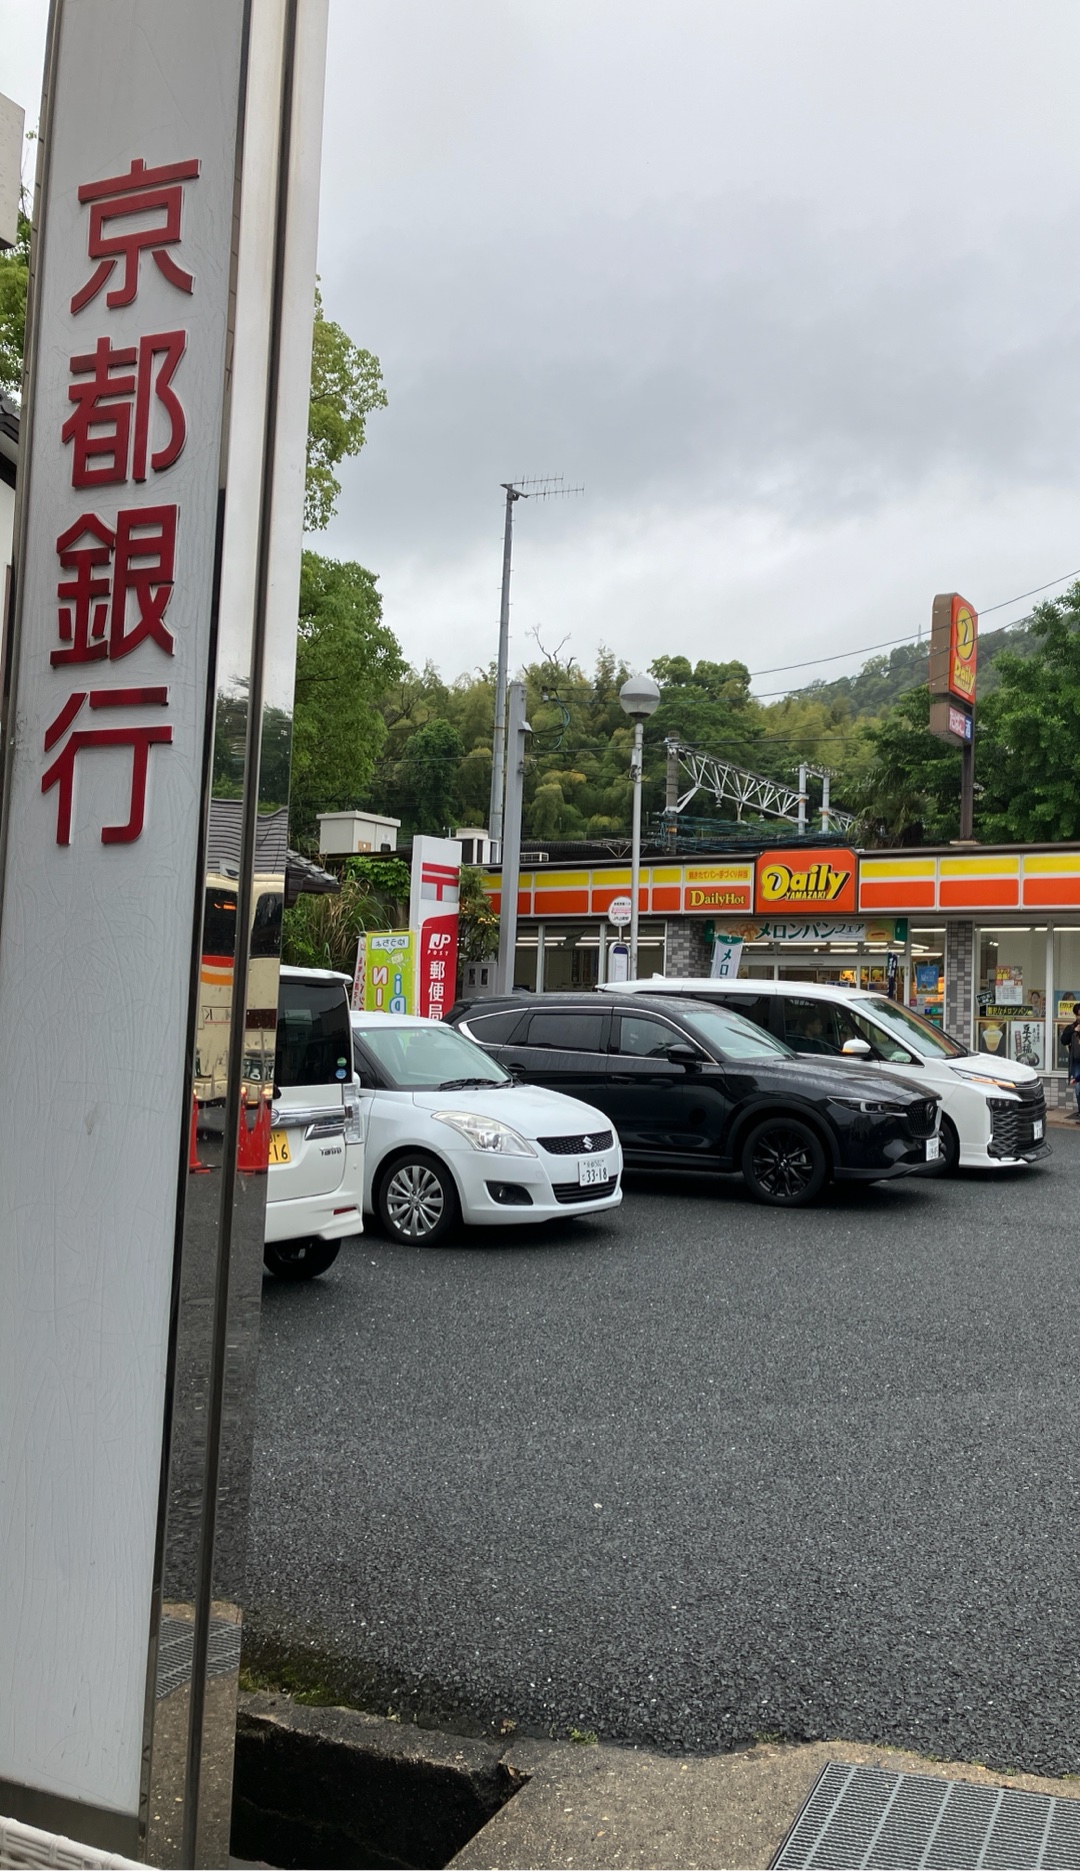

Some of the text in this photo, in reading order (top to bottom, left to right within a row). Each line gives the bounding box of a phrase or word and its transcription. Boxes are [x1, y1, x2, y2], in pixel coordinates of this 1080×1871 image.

[42, 158, 201, 846] 京都銀行
[953, 656, 976, 695] Daily
[761, 864, 851, 901] Daily
[785, 890, 827, 900] YAMAZAKI
[428, 933, 452, 950] JP
[719, 948, 732, 979] メロ
[428, 960, 446, 1021] 郵便局
